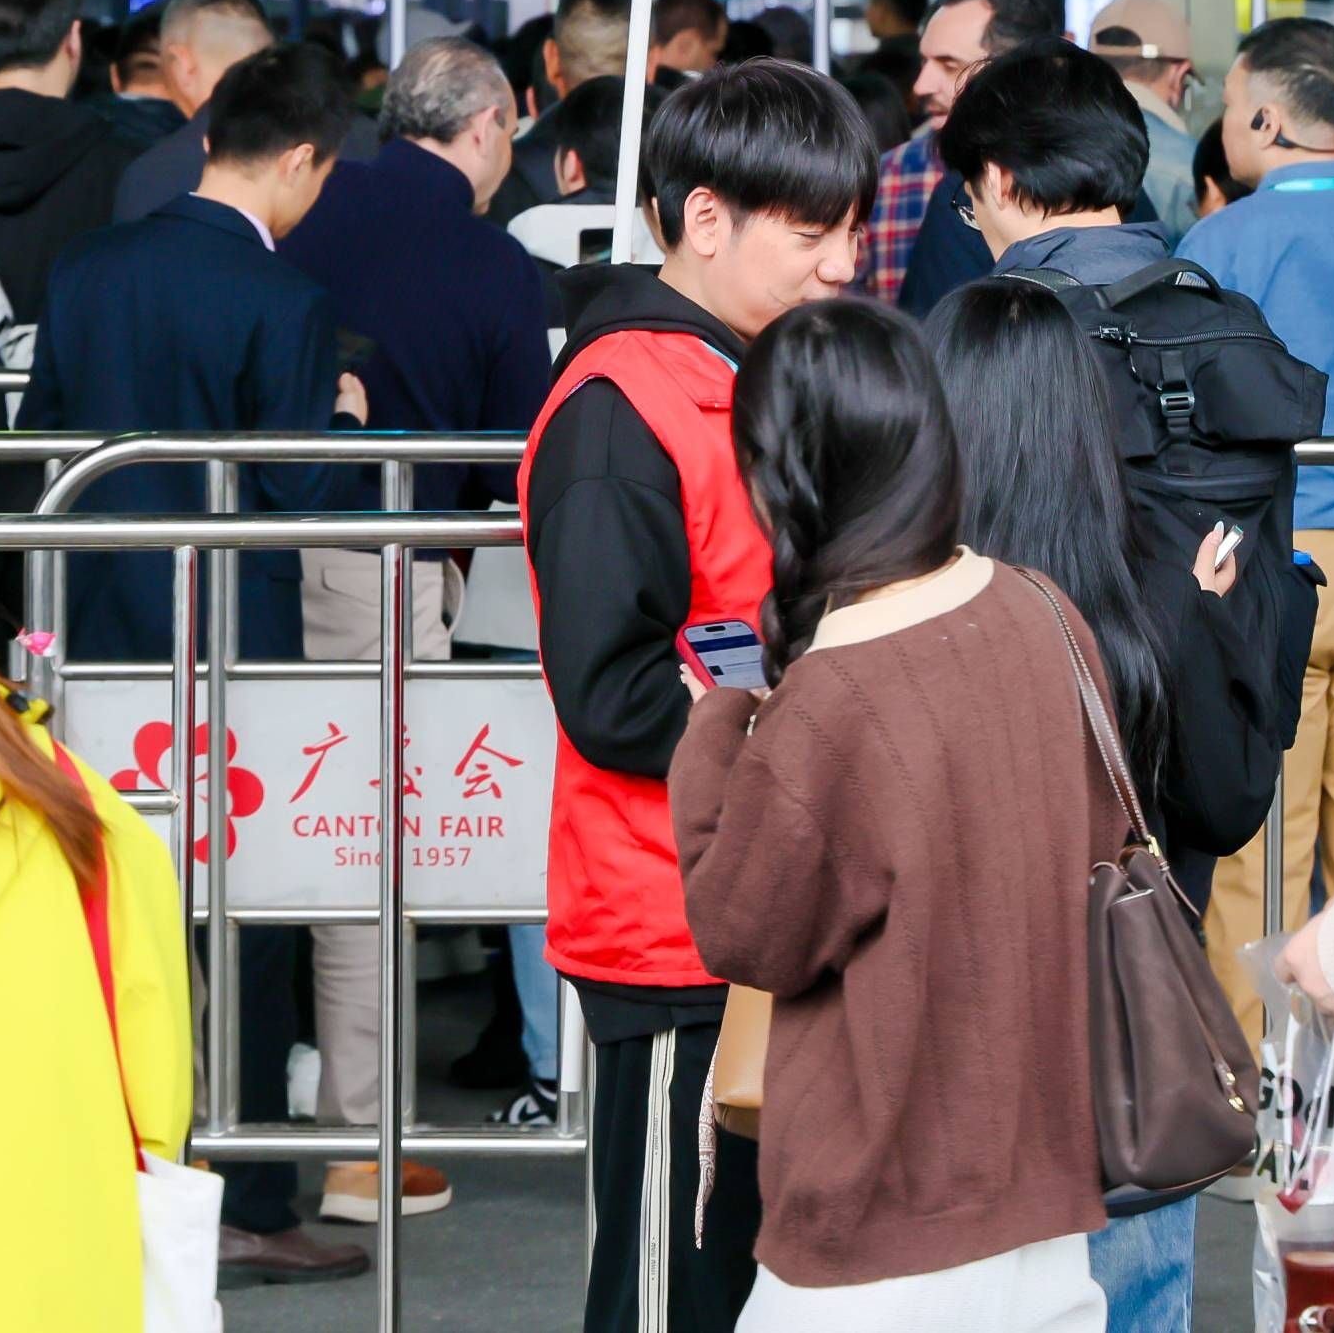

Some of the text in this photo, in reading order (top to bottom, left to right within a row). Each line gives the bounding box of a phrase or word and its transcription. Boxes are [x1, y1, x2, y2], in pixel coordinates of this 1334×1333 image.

[292, 814, 505, 838] CANTN FAIR
[411, 846, 472, 868] 1957
